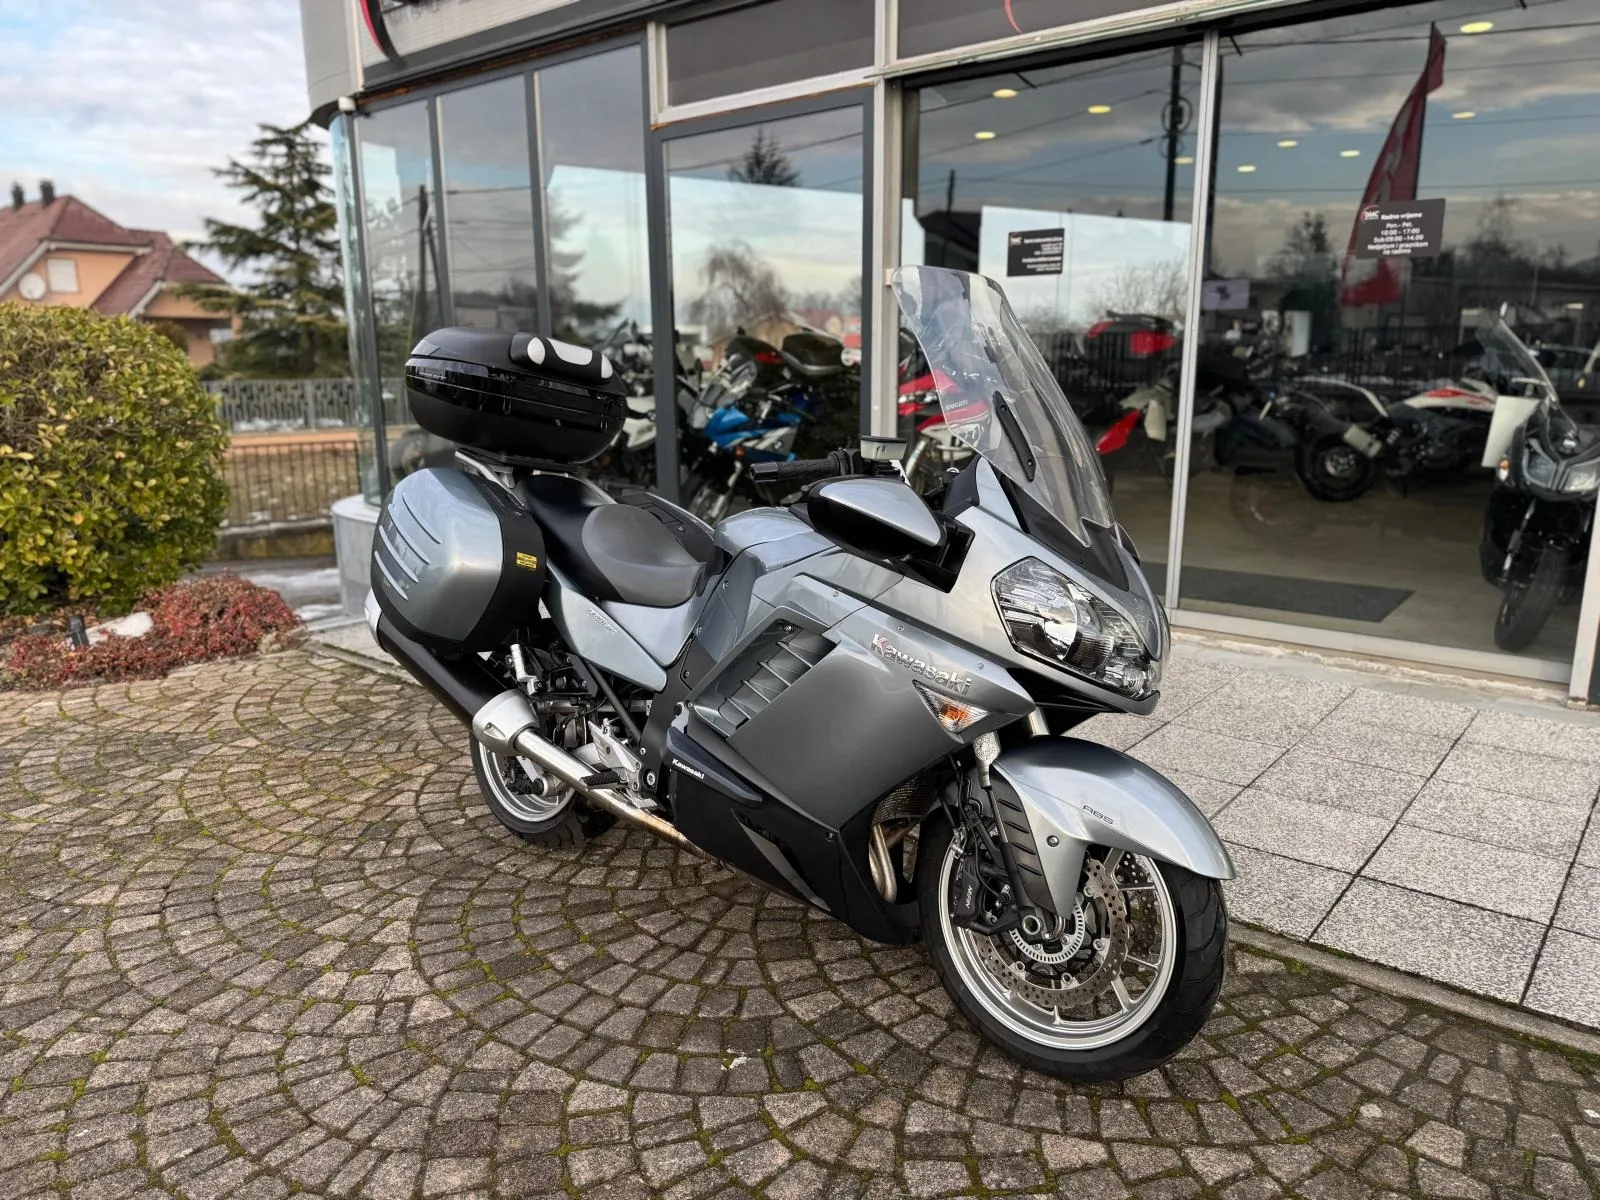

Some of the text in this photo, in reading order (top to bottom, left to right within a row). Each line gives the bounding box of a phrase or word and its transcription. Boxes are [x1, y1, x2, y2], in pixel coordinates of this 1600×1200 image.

[1400, 212, 1423, 220] vrijeme
[946, 399, 969, 410] DUCATI
[871, 633, 972, 695] Kawasaki
[672, 758, 705, 779] Kawasaki
[1082, 804, 1114, 825] ABS
